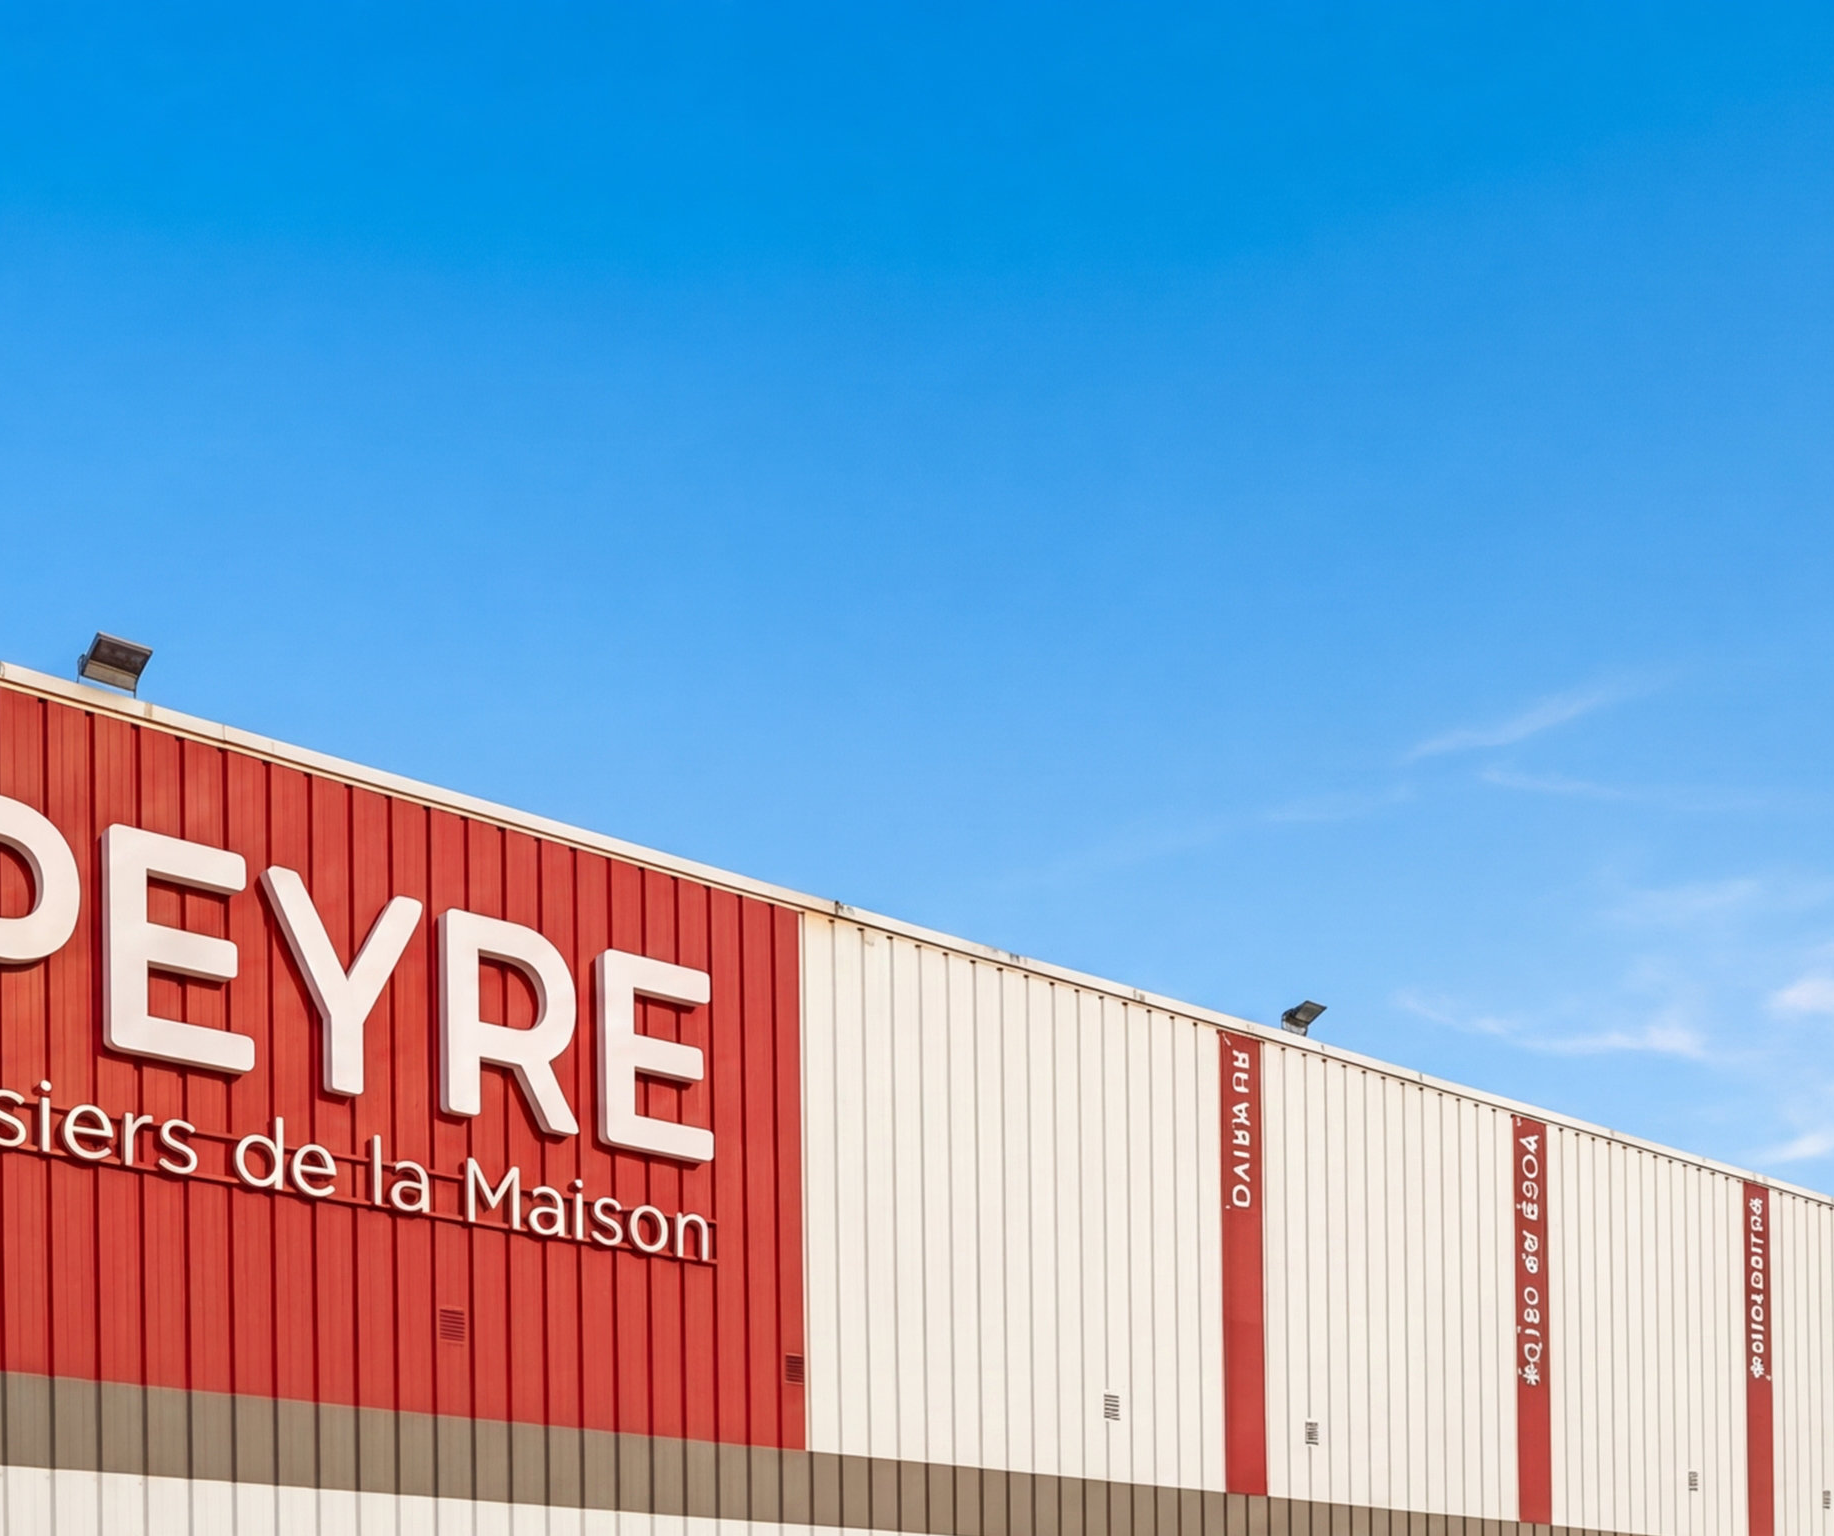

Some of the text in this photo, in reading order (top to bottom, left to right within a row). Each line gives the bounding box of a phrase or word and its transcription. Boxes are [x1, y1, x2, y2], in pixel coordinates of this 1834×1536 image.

[233, 1117, 338, 1198] de
[371, 1134, 431, 1214] la
[464, 1157, 711, 1262] Maison
